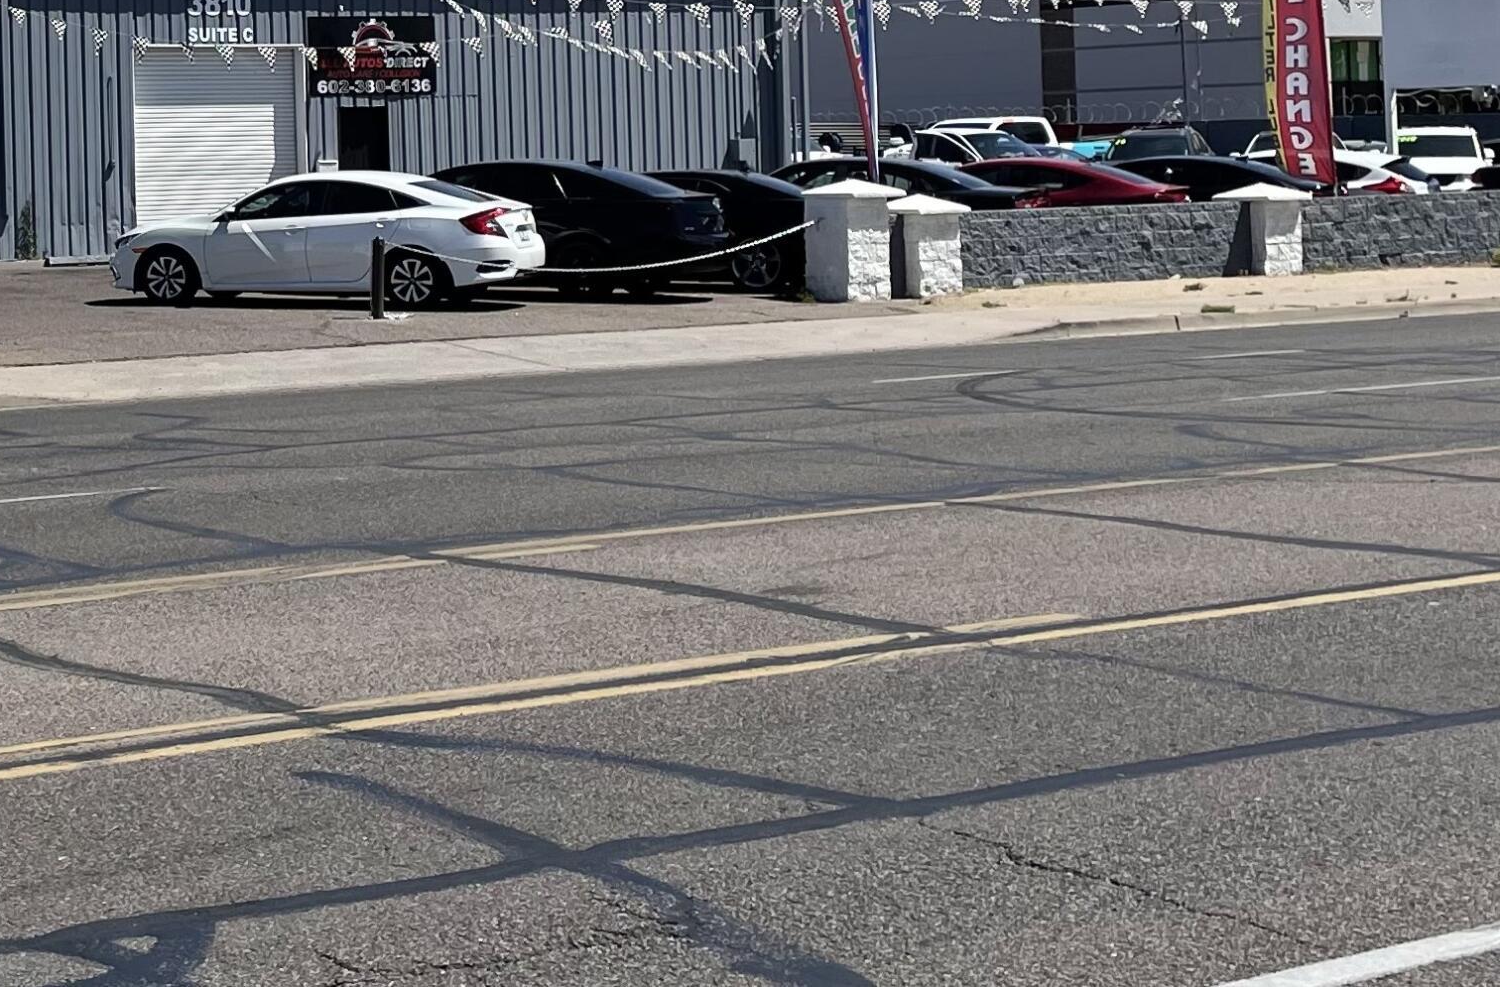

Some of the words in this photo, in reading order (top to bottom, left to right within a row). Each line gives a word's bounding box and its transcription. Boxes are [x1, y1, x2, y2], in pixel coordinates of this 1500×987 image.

[188, 27, 238, 43] SUITE
[242, 27, 253, 43] C
[386, 56, 429, 68] DIRECT
[317, 78, 431, 93] 602-380-6136
